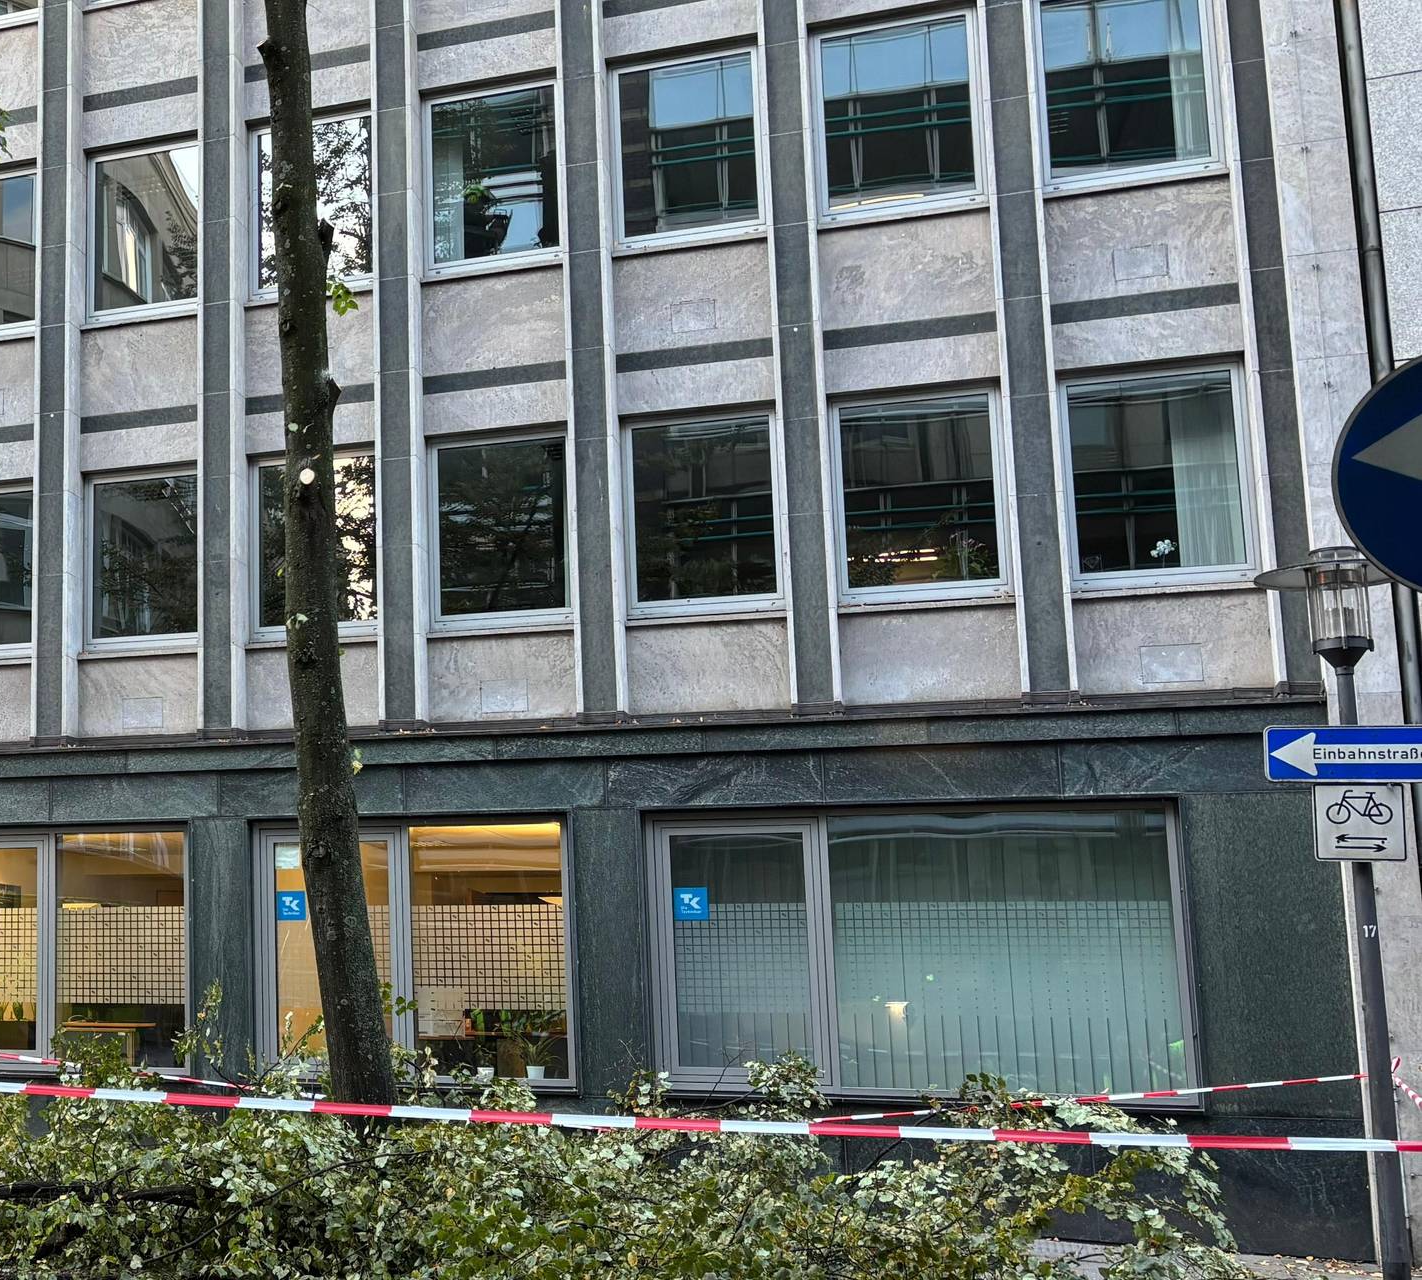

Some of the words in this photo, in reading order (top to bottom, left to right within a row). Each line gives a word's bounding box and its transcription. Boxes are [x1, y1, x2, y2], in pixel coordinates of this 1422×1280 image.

[1313, 748, 1422, 760] Einbahnstraß
[282, 896, 300, 911] TK
[680, 893, 702, 909] TK
[1363, 924, 1376, 938] 17
